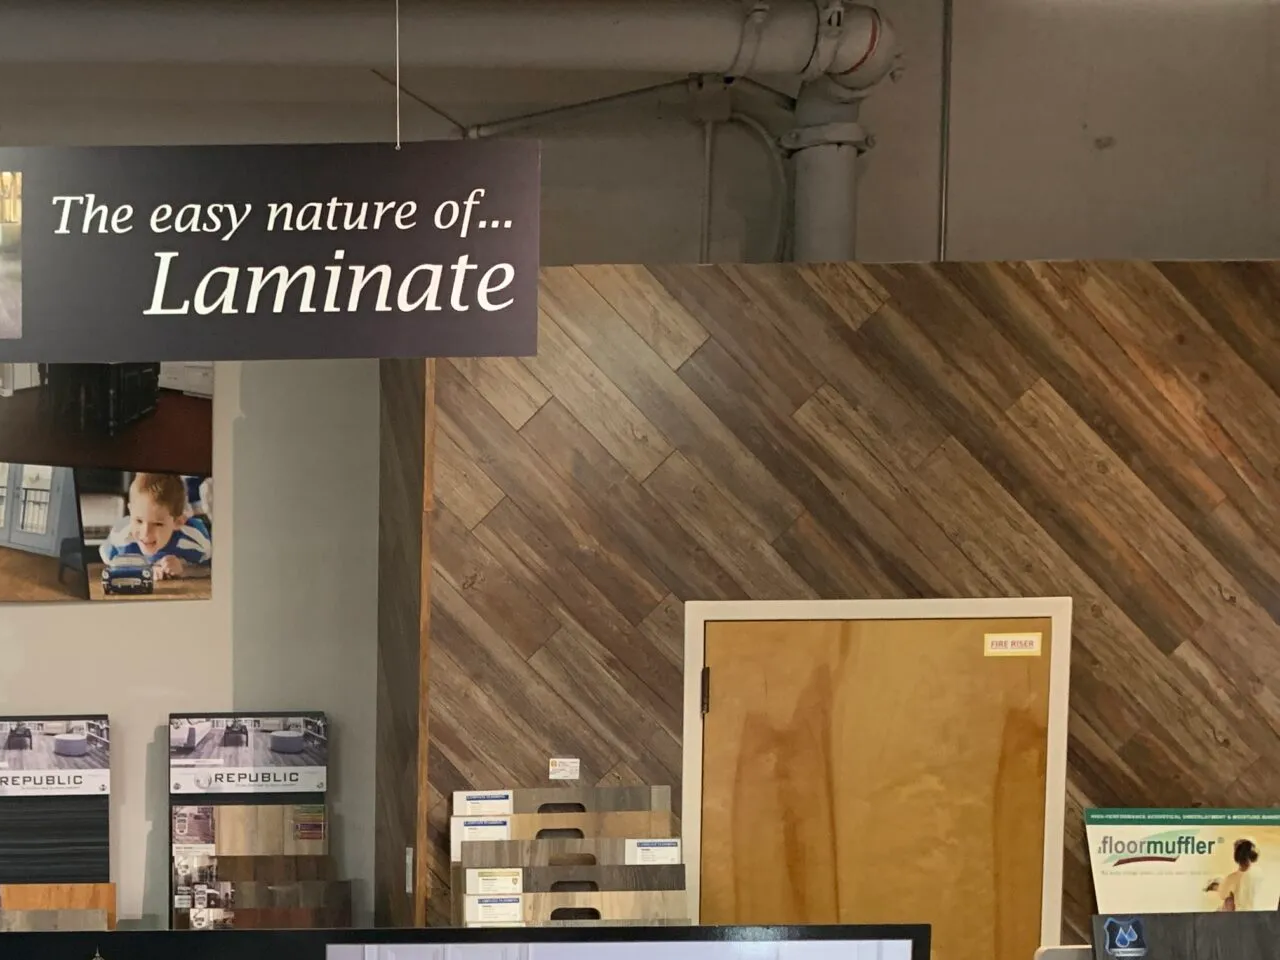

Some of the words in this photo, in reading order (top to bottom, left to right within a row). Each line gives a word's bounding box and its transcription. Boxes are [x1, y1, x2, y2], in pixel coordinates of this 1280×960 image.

[51, 194, 134, 235] The
[150, 202, 252, 241] easy
[266, 195, 418, 232] nature
[433, 188, 514, 239] of...
[142, 249, 517, 317] Laminate
[990, 640, 1008, 649] FIRE
[1010, 639, 1035, 649] RISER
[0, 774, 84, 786] REPUBLIC
[214, 771, 300, 783] REPUBLIC
